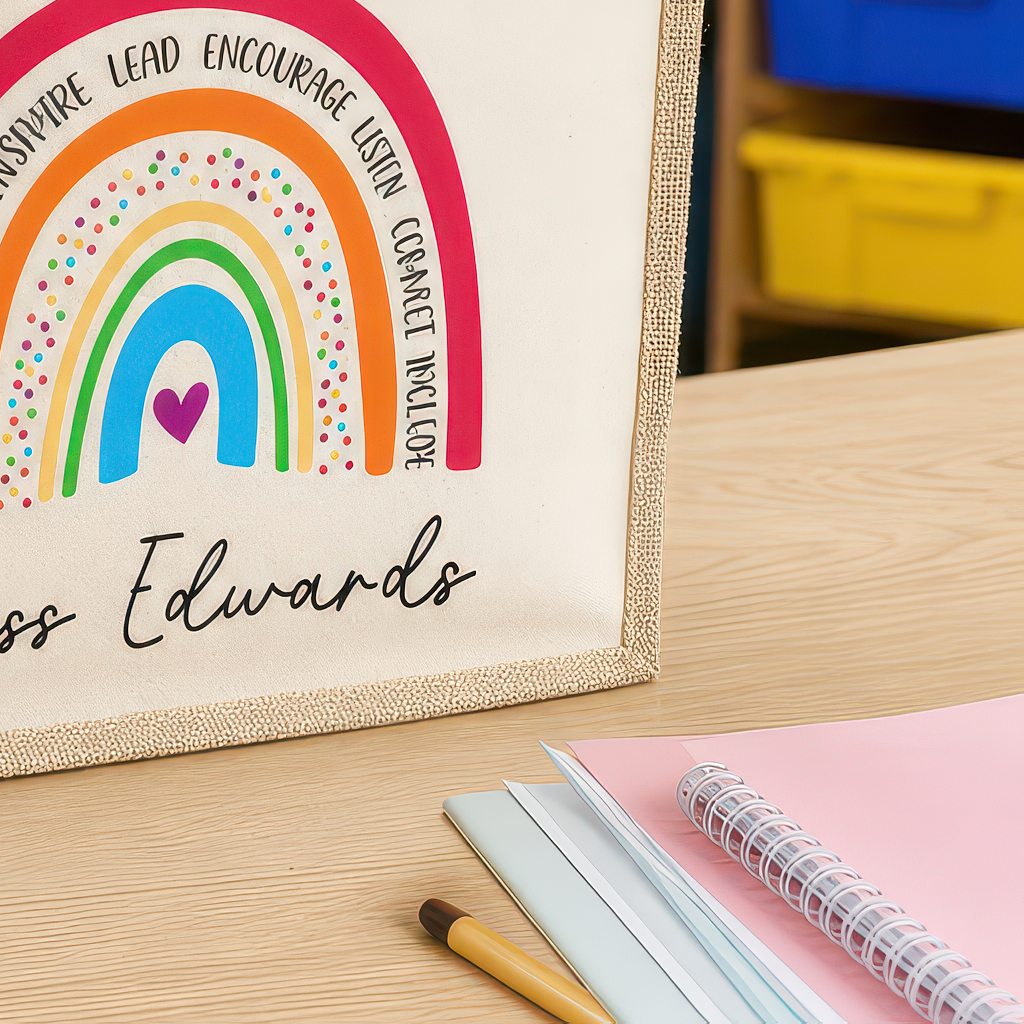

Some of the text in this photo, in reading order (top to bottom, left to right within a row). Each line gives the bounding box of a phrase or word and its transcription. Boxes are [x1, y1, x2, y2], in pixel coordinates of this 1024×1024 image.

[107, 35, 181, 89] LEAD
[203, 33, 359, 123] ENCOURAGE
[123, 514, 477, 649] Edwards
